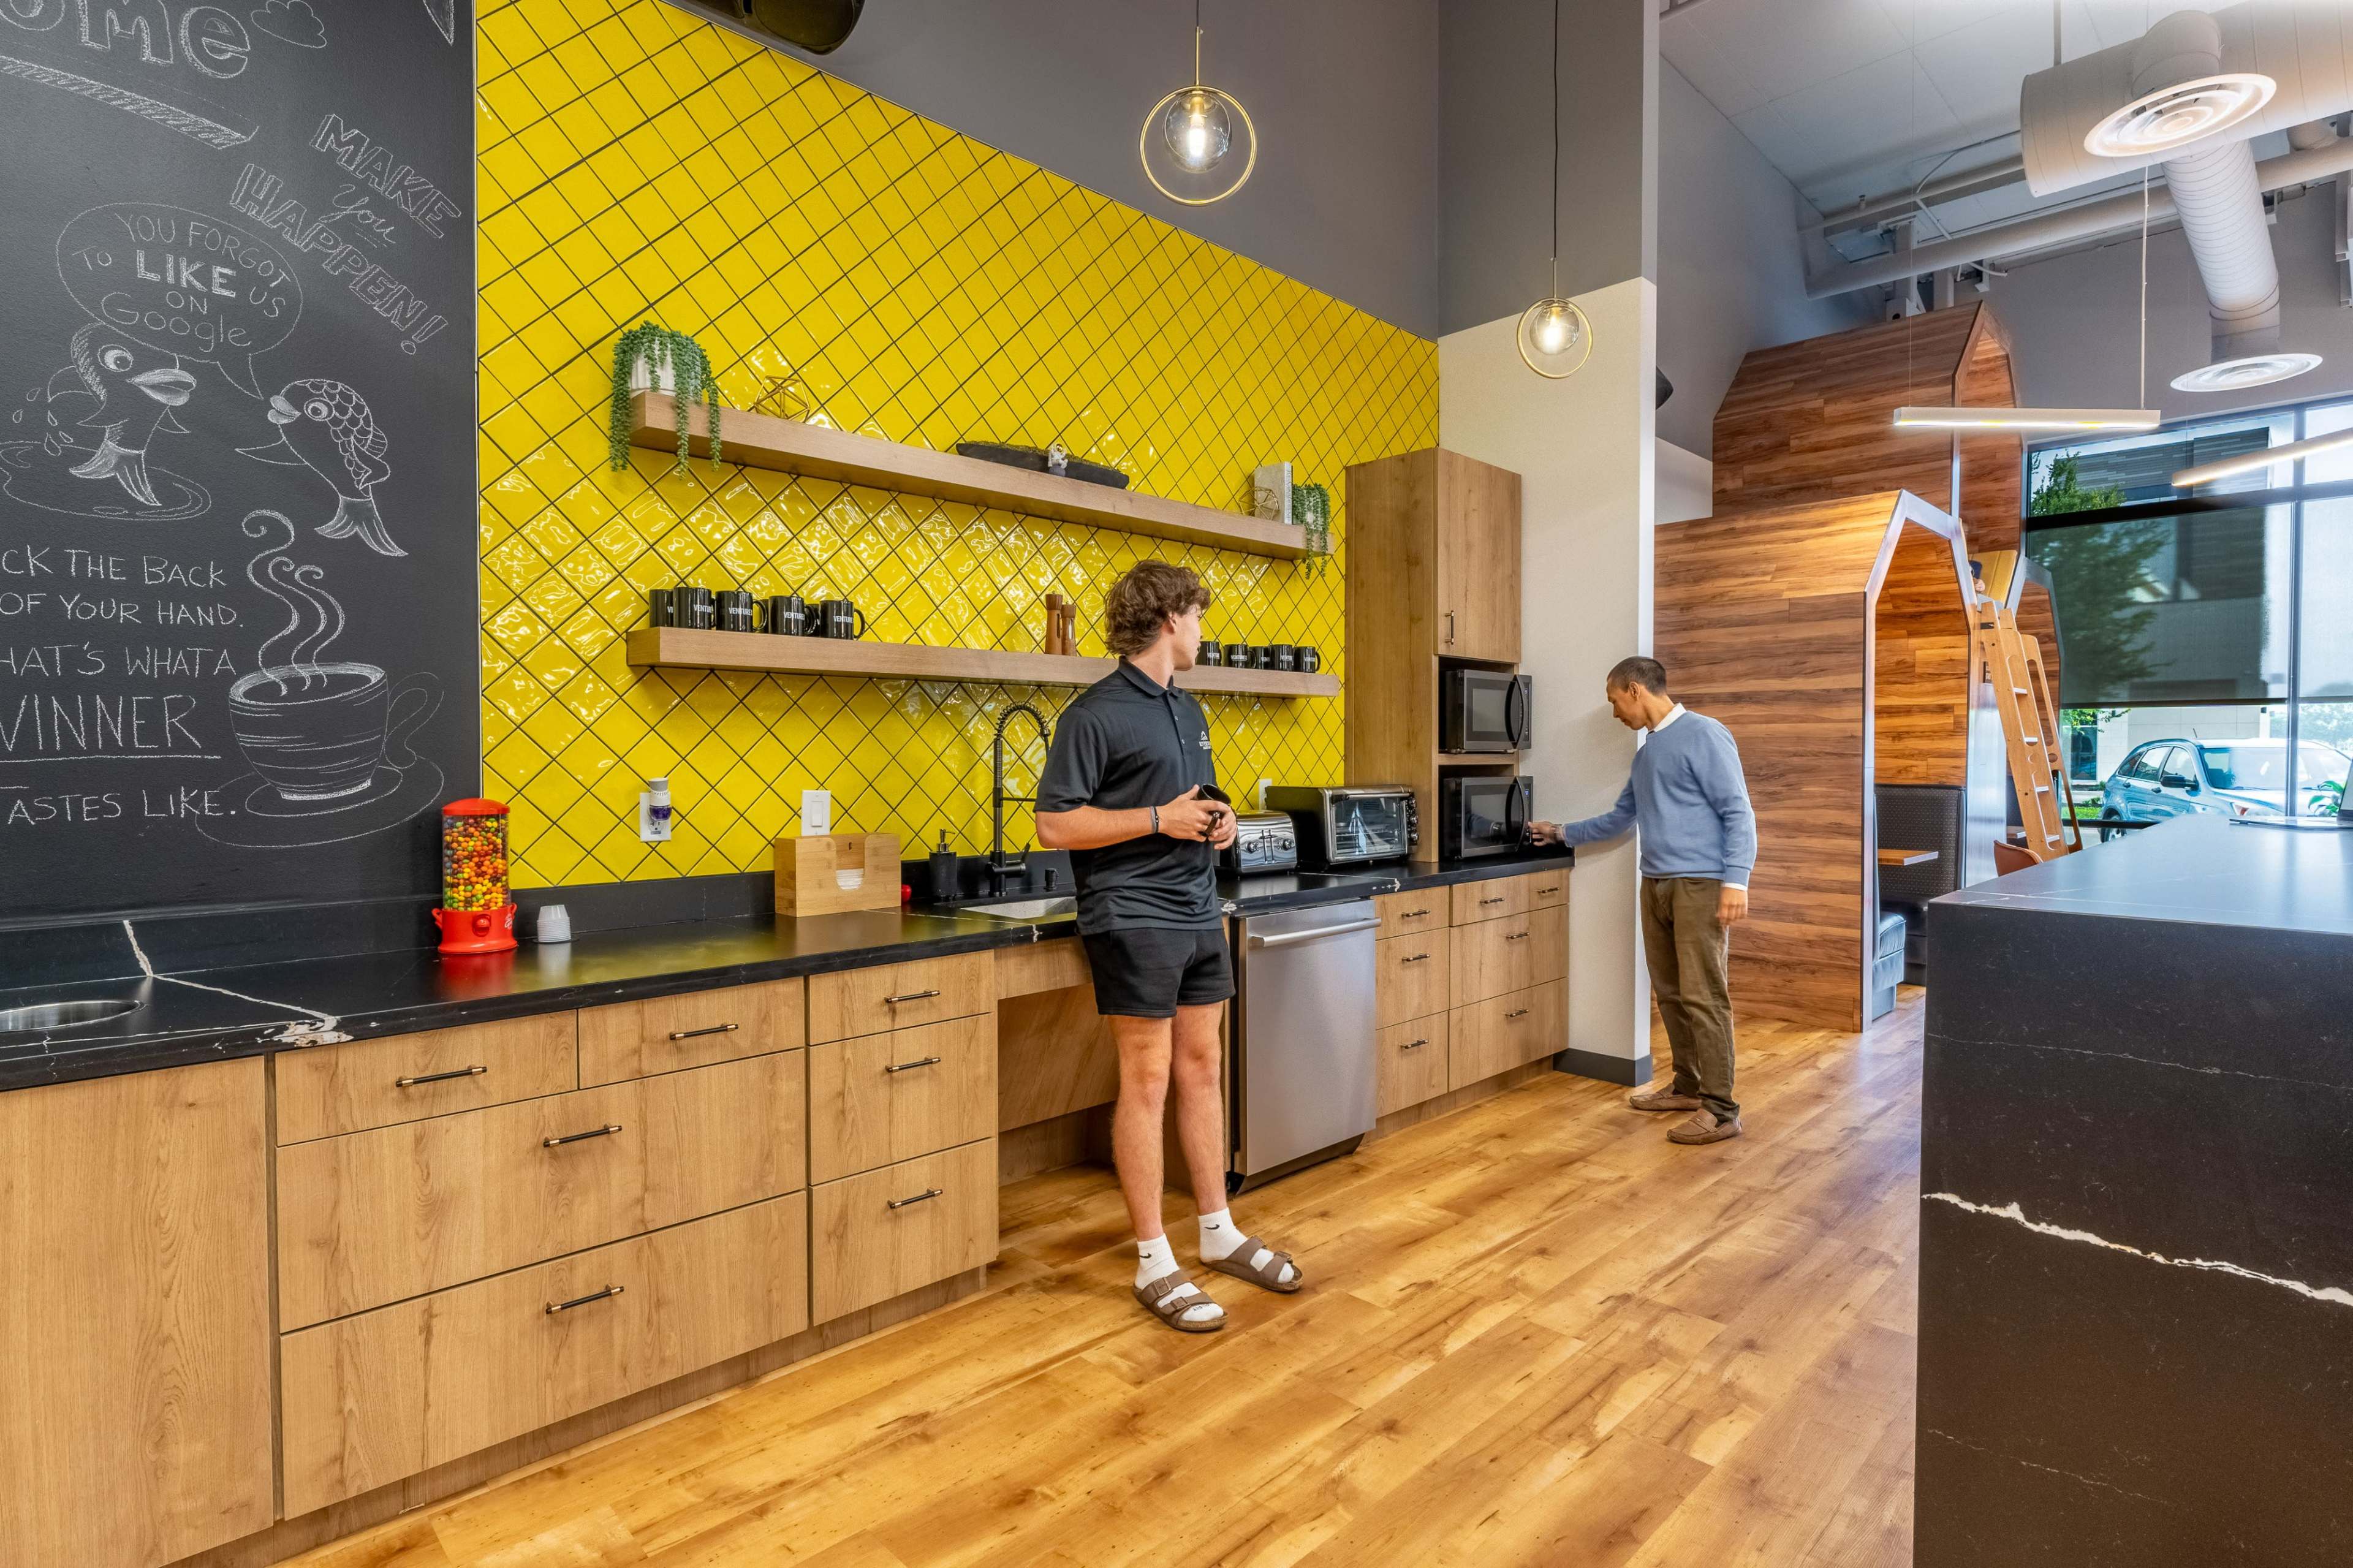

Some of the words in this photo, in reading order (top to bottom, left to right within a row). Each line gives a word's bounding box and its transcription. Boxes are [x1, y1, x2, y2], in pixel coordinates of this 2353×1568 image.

[309, 113, 461, 238] MAKE
[115, 213, 176, 243] YOU
[189, 221, 291, 287] FORGOT
[230, 164, 449, 355] HAPPEN!
[137, 249, 237, 298] LIKE
[249, 286, 286, 317] US
[166, 290, 207, 314] ON
[100, 292, 252, 352] Google
[64, 549, 127, 580] THE
[143, 555, 227, 588] BACK
[0, 592, 47, 615] OF
[59, 593, 142, 624] YOUR
[157, 600, 243, 627] HAND.
[142, 786, 236, 818] LIKE.
